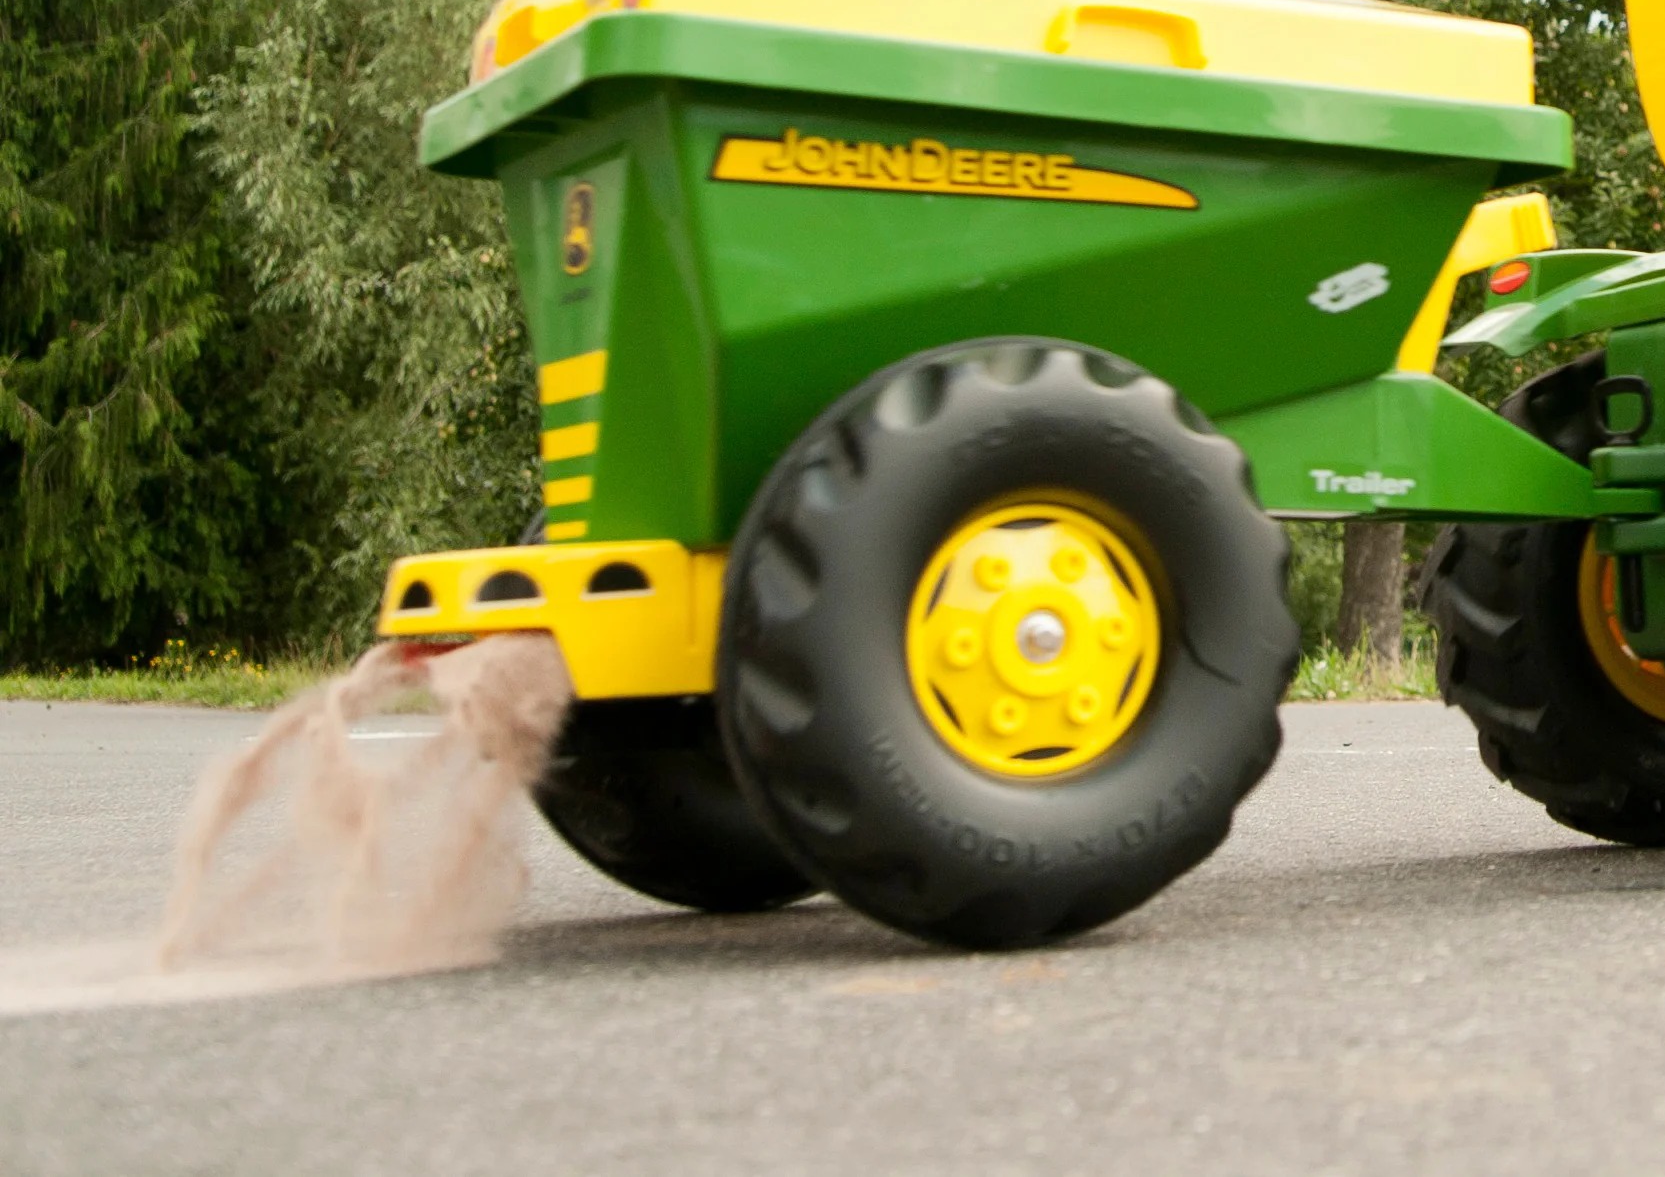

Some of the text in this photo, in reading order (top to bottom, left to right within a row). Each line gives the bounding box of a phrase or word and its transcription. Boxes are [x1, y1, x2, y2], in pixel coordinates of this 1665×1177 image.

[763, 127, 1077, 191] JOHN DEERE
[1308, 468, 1416, 496] Trailer
